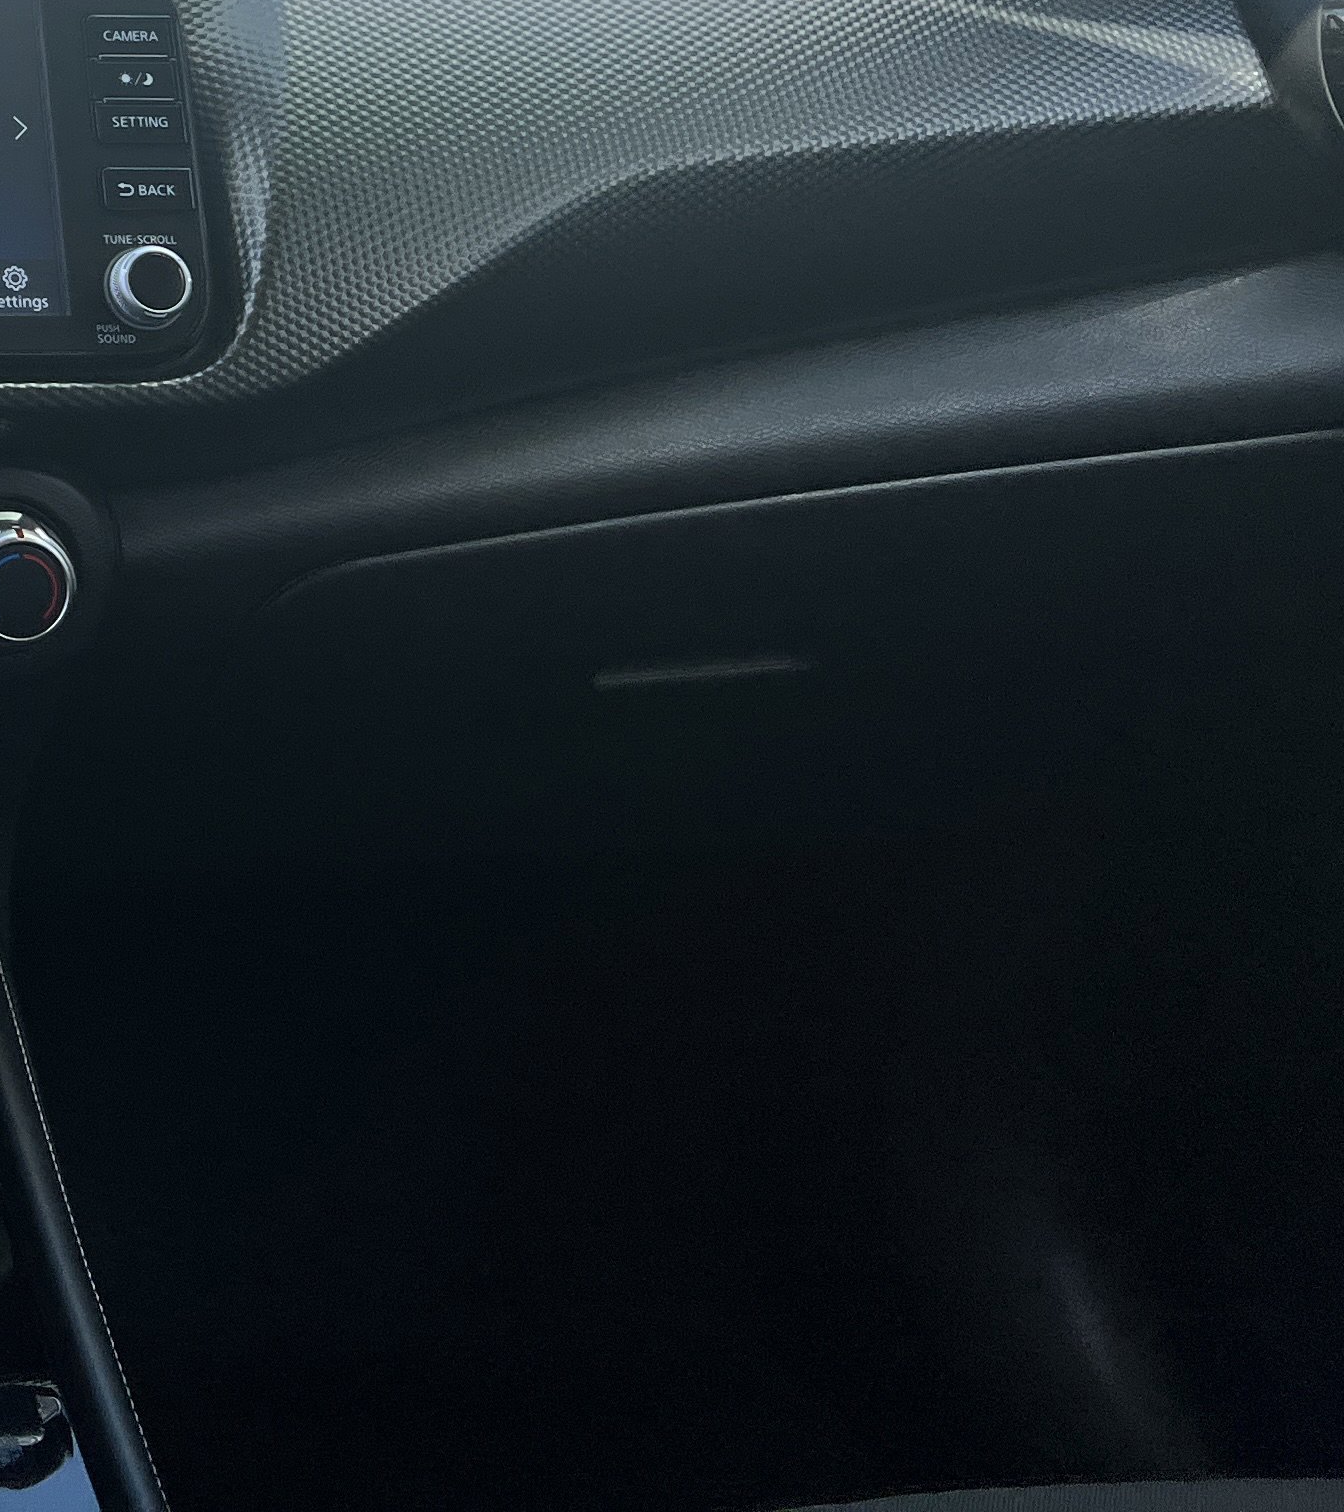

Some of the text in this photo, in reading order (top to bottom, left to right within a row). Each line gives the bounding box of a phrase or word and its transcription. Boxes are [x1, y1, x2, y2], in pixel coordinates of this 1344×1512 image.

[103, 30, 159, 42] CAMERA
[112, 116, 169, 128] SETTING
[138, 184, 176, 196] BACK
[96, 324, 120, 332] PUSH
[97, 334, 136, 344] SOUND
